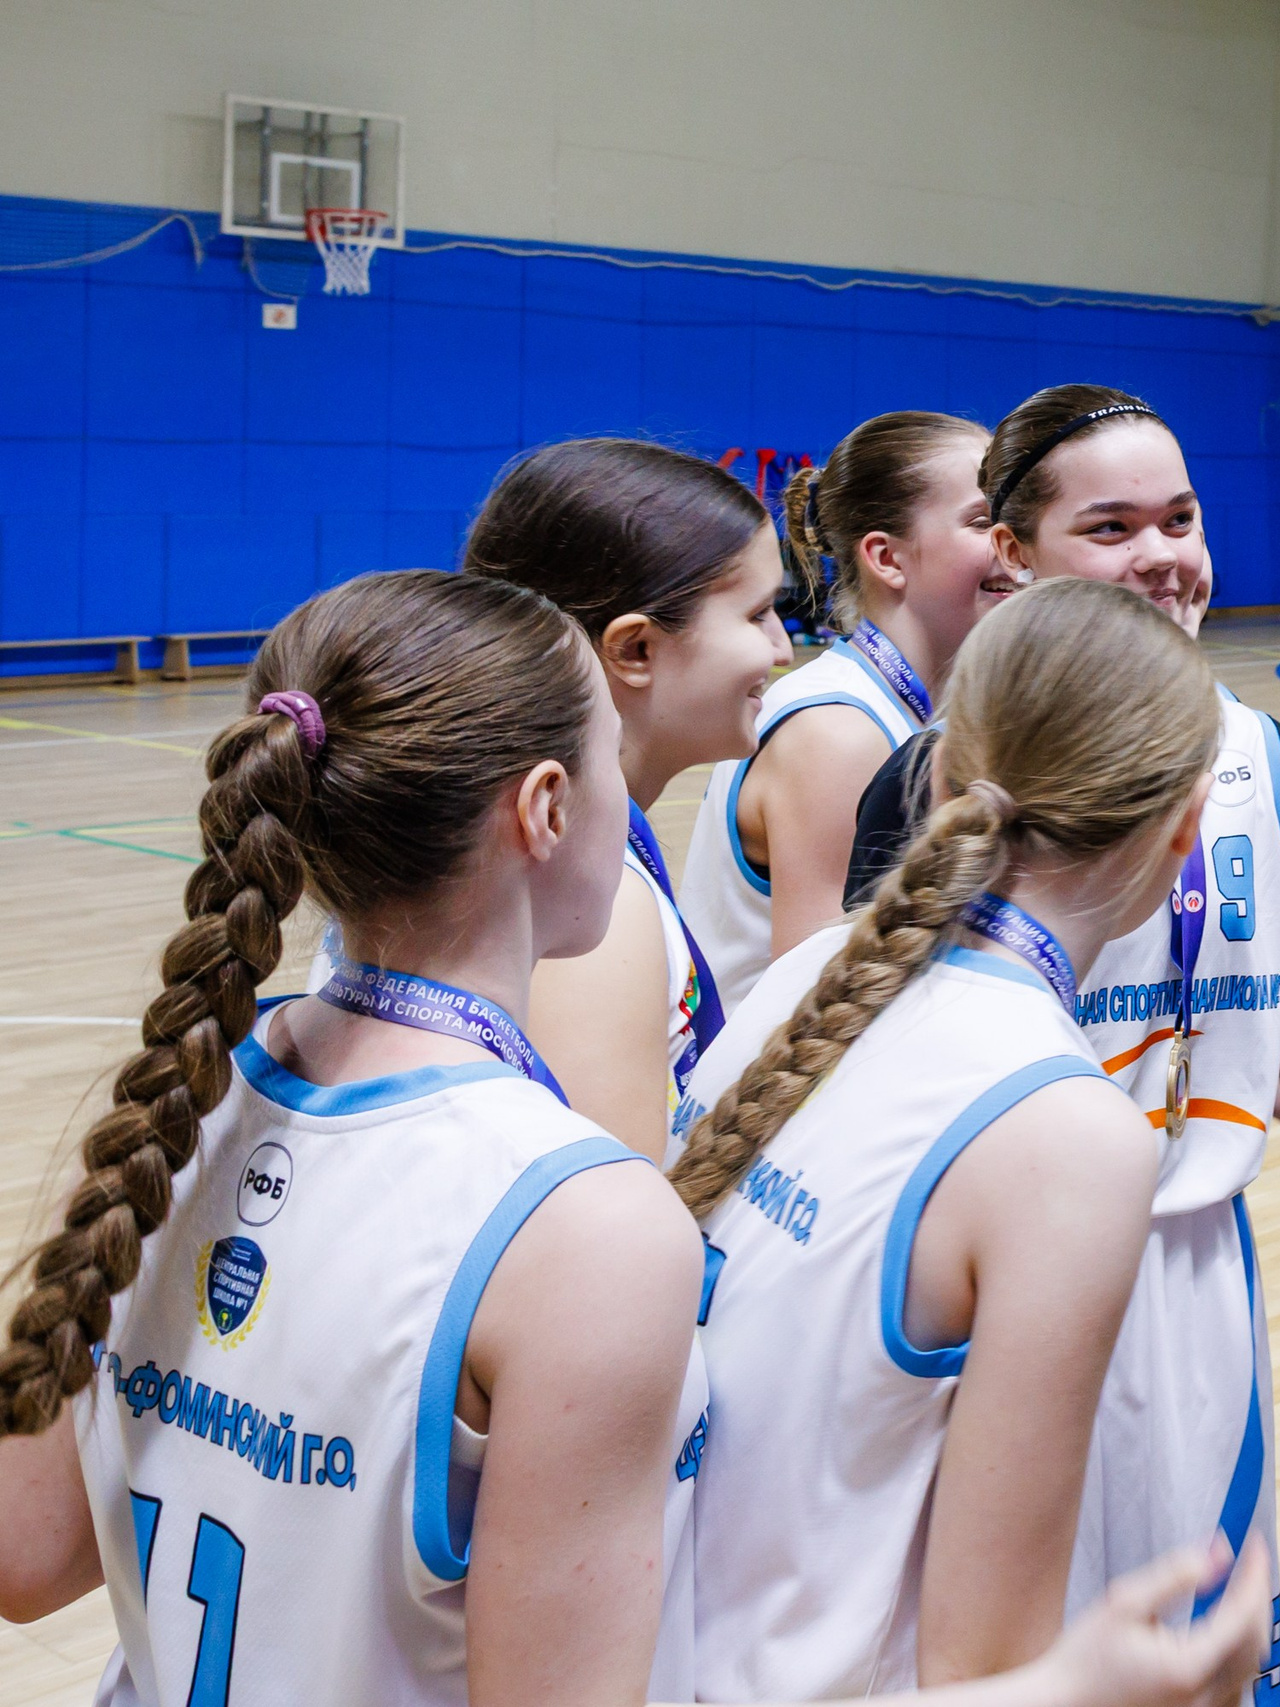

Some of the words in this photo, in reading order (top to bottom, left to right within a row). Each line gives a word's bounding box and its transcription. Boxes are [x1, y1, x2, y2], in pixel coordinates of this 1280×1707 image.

[865, 641, 912, 696] МОСКОВСКОЙ
[871, 633, 914, 682] БАСКЕТБОЛА
[1217, 765, 1252, 785] ФБ
[1211, 834, 1256, 942] 9
[365, 972, 466, 1010] ФЕДЕРАЦИЯ
[468, 999, 534, 1068] БАСКЕТБОЛА
[377, 995, 391, 1011] И
[394, 1001, 463, 1031] СПОРТА
[243, 1168, 286, 1200] РФБ
